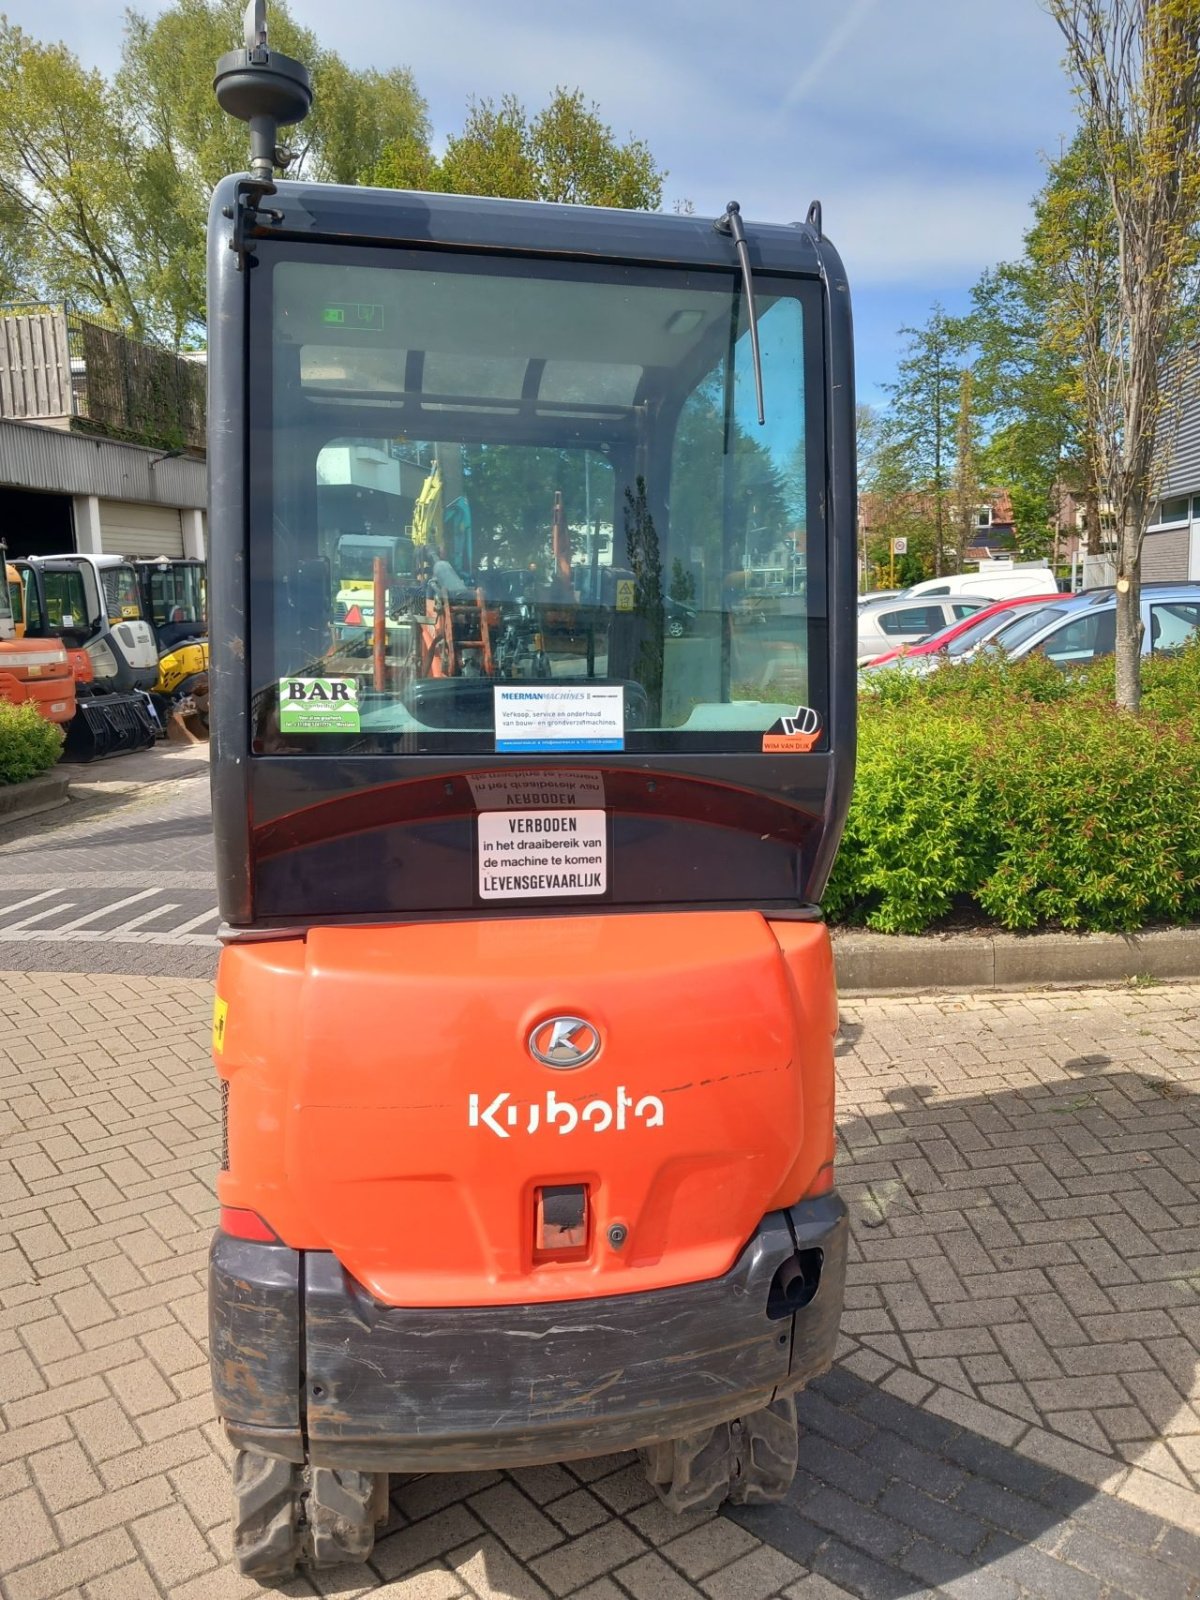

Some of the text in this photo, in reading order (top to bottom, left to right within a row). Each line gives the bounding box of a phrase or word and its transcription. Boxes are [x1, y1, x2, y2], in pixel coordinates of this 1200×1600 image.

[288, 682, 350, 700] BAR
[508, 817, 577, 833] VERBODEN
[483, 838, 602, 851] in het draaibereik van
[483, 854, 602, 868] de machine te komen
[484, 872, 602, 892] LEVENSGEVAARLIJK
[468, 1085, 664, 1138] Kubota
